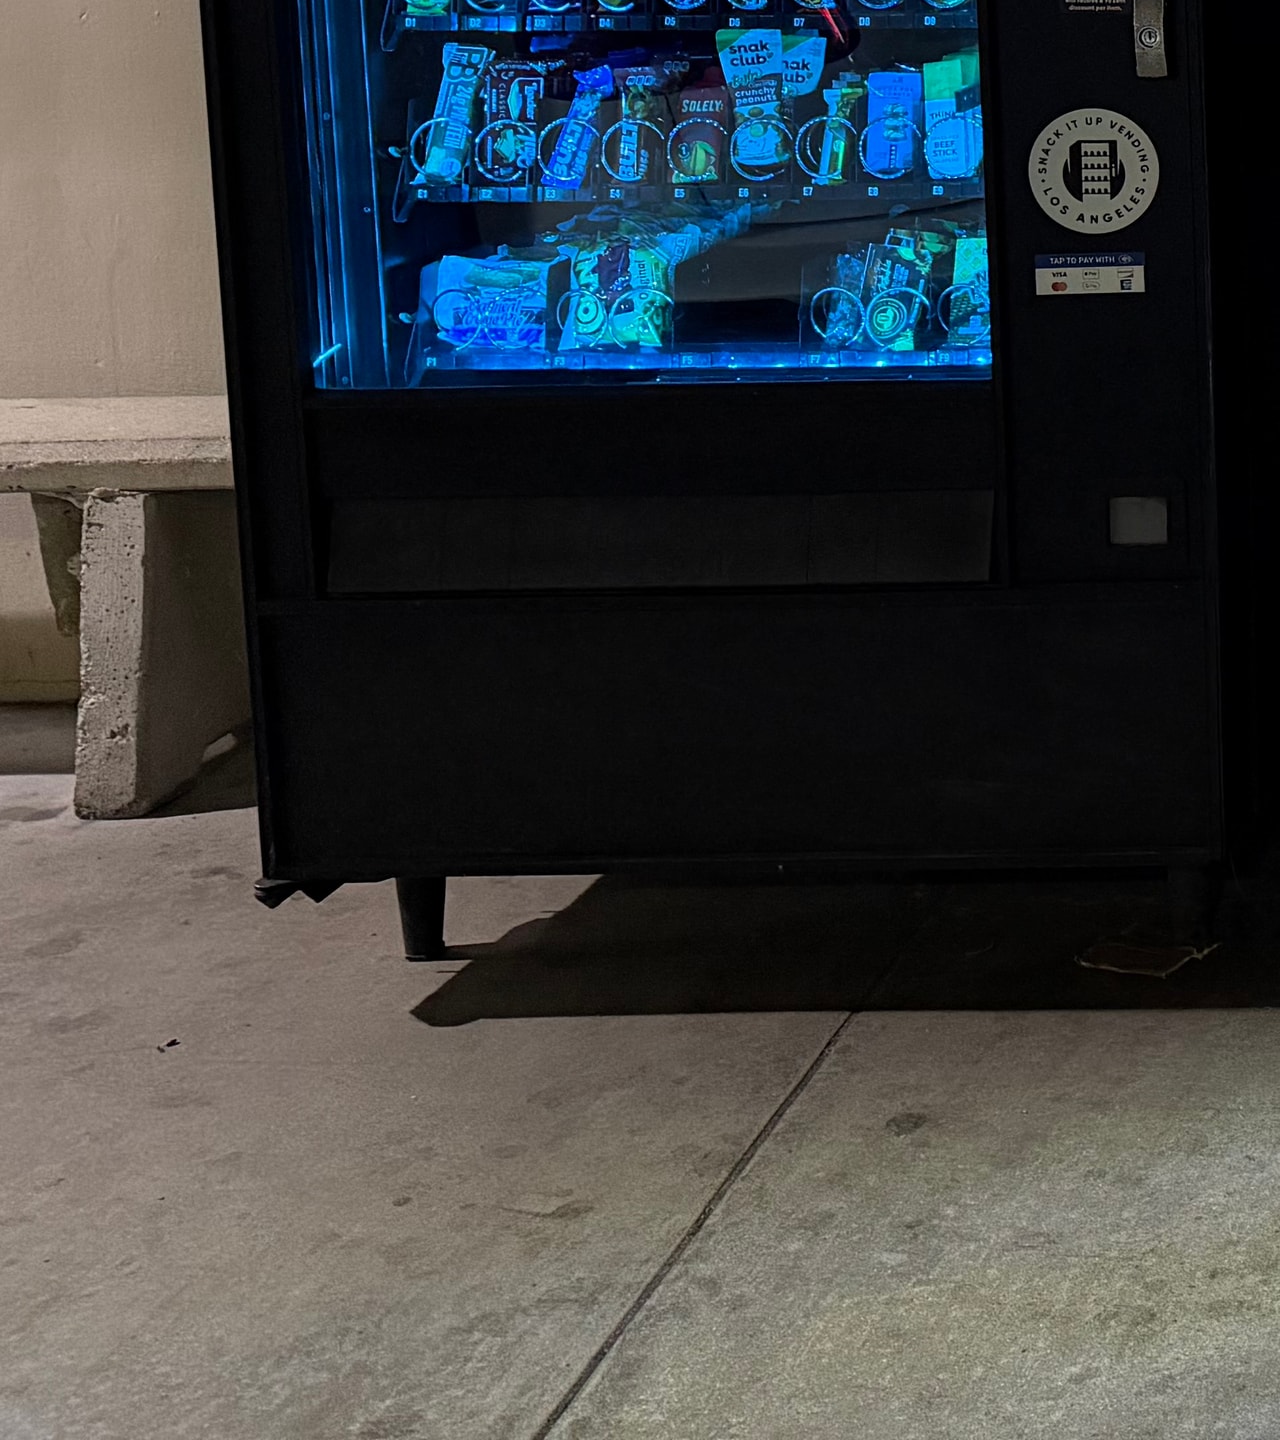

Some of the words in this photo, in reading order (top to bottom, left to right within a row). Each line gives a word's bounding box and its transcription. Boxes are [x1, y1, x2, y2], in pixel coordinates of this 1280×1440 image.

[729, 40, 769, 54] snak
[730, 55, 767, 66] club
[735, 86, 776, 98] crunchy
[735, 94, 777, 106] peanuts
[934, 140, 955, 148] BEEF
[1038, 129, 1063, 175] SNACK
[1066, 119, 1079, 131] IT
[1085, 117, 1103, 125] UP
[1109, 120, 1149, 173] VENDING
[933, 148, 957, 157] STICK
[1043, 187, 1069, 215] LOS
[1076, 186, 1145, 224] ANGELES
